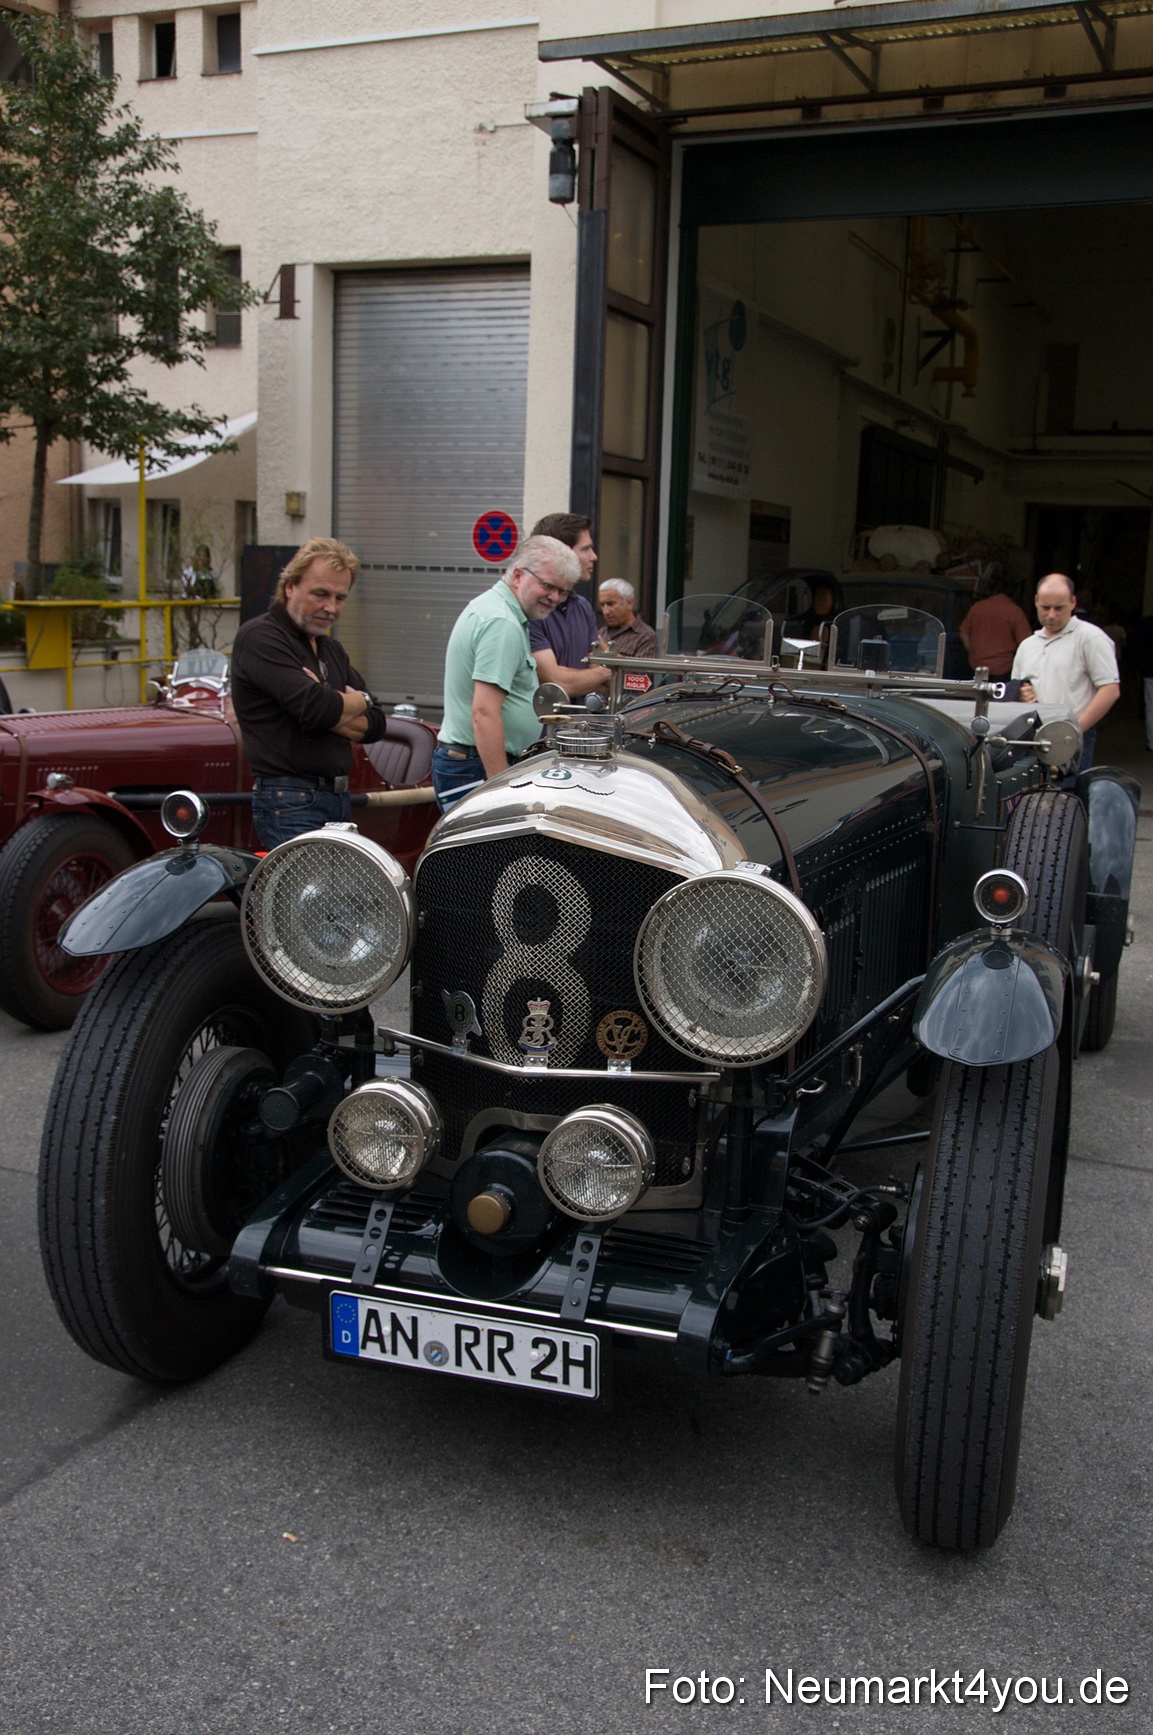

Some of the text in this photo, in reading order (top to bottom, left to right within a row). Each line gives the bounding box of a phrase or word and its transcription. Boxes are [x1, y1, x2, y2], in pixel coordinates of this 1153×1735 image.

[263, 264, 301, 320] 4
[545, 768, 567, 779] B
[482, 855, 592, 1083] 8
[341, 1330, 352, 1344] D
[361, 1308, 593, 1390] AN RR 2H
